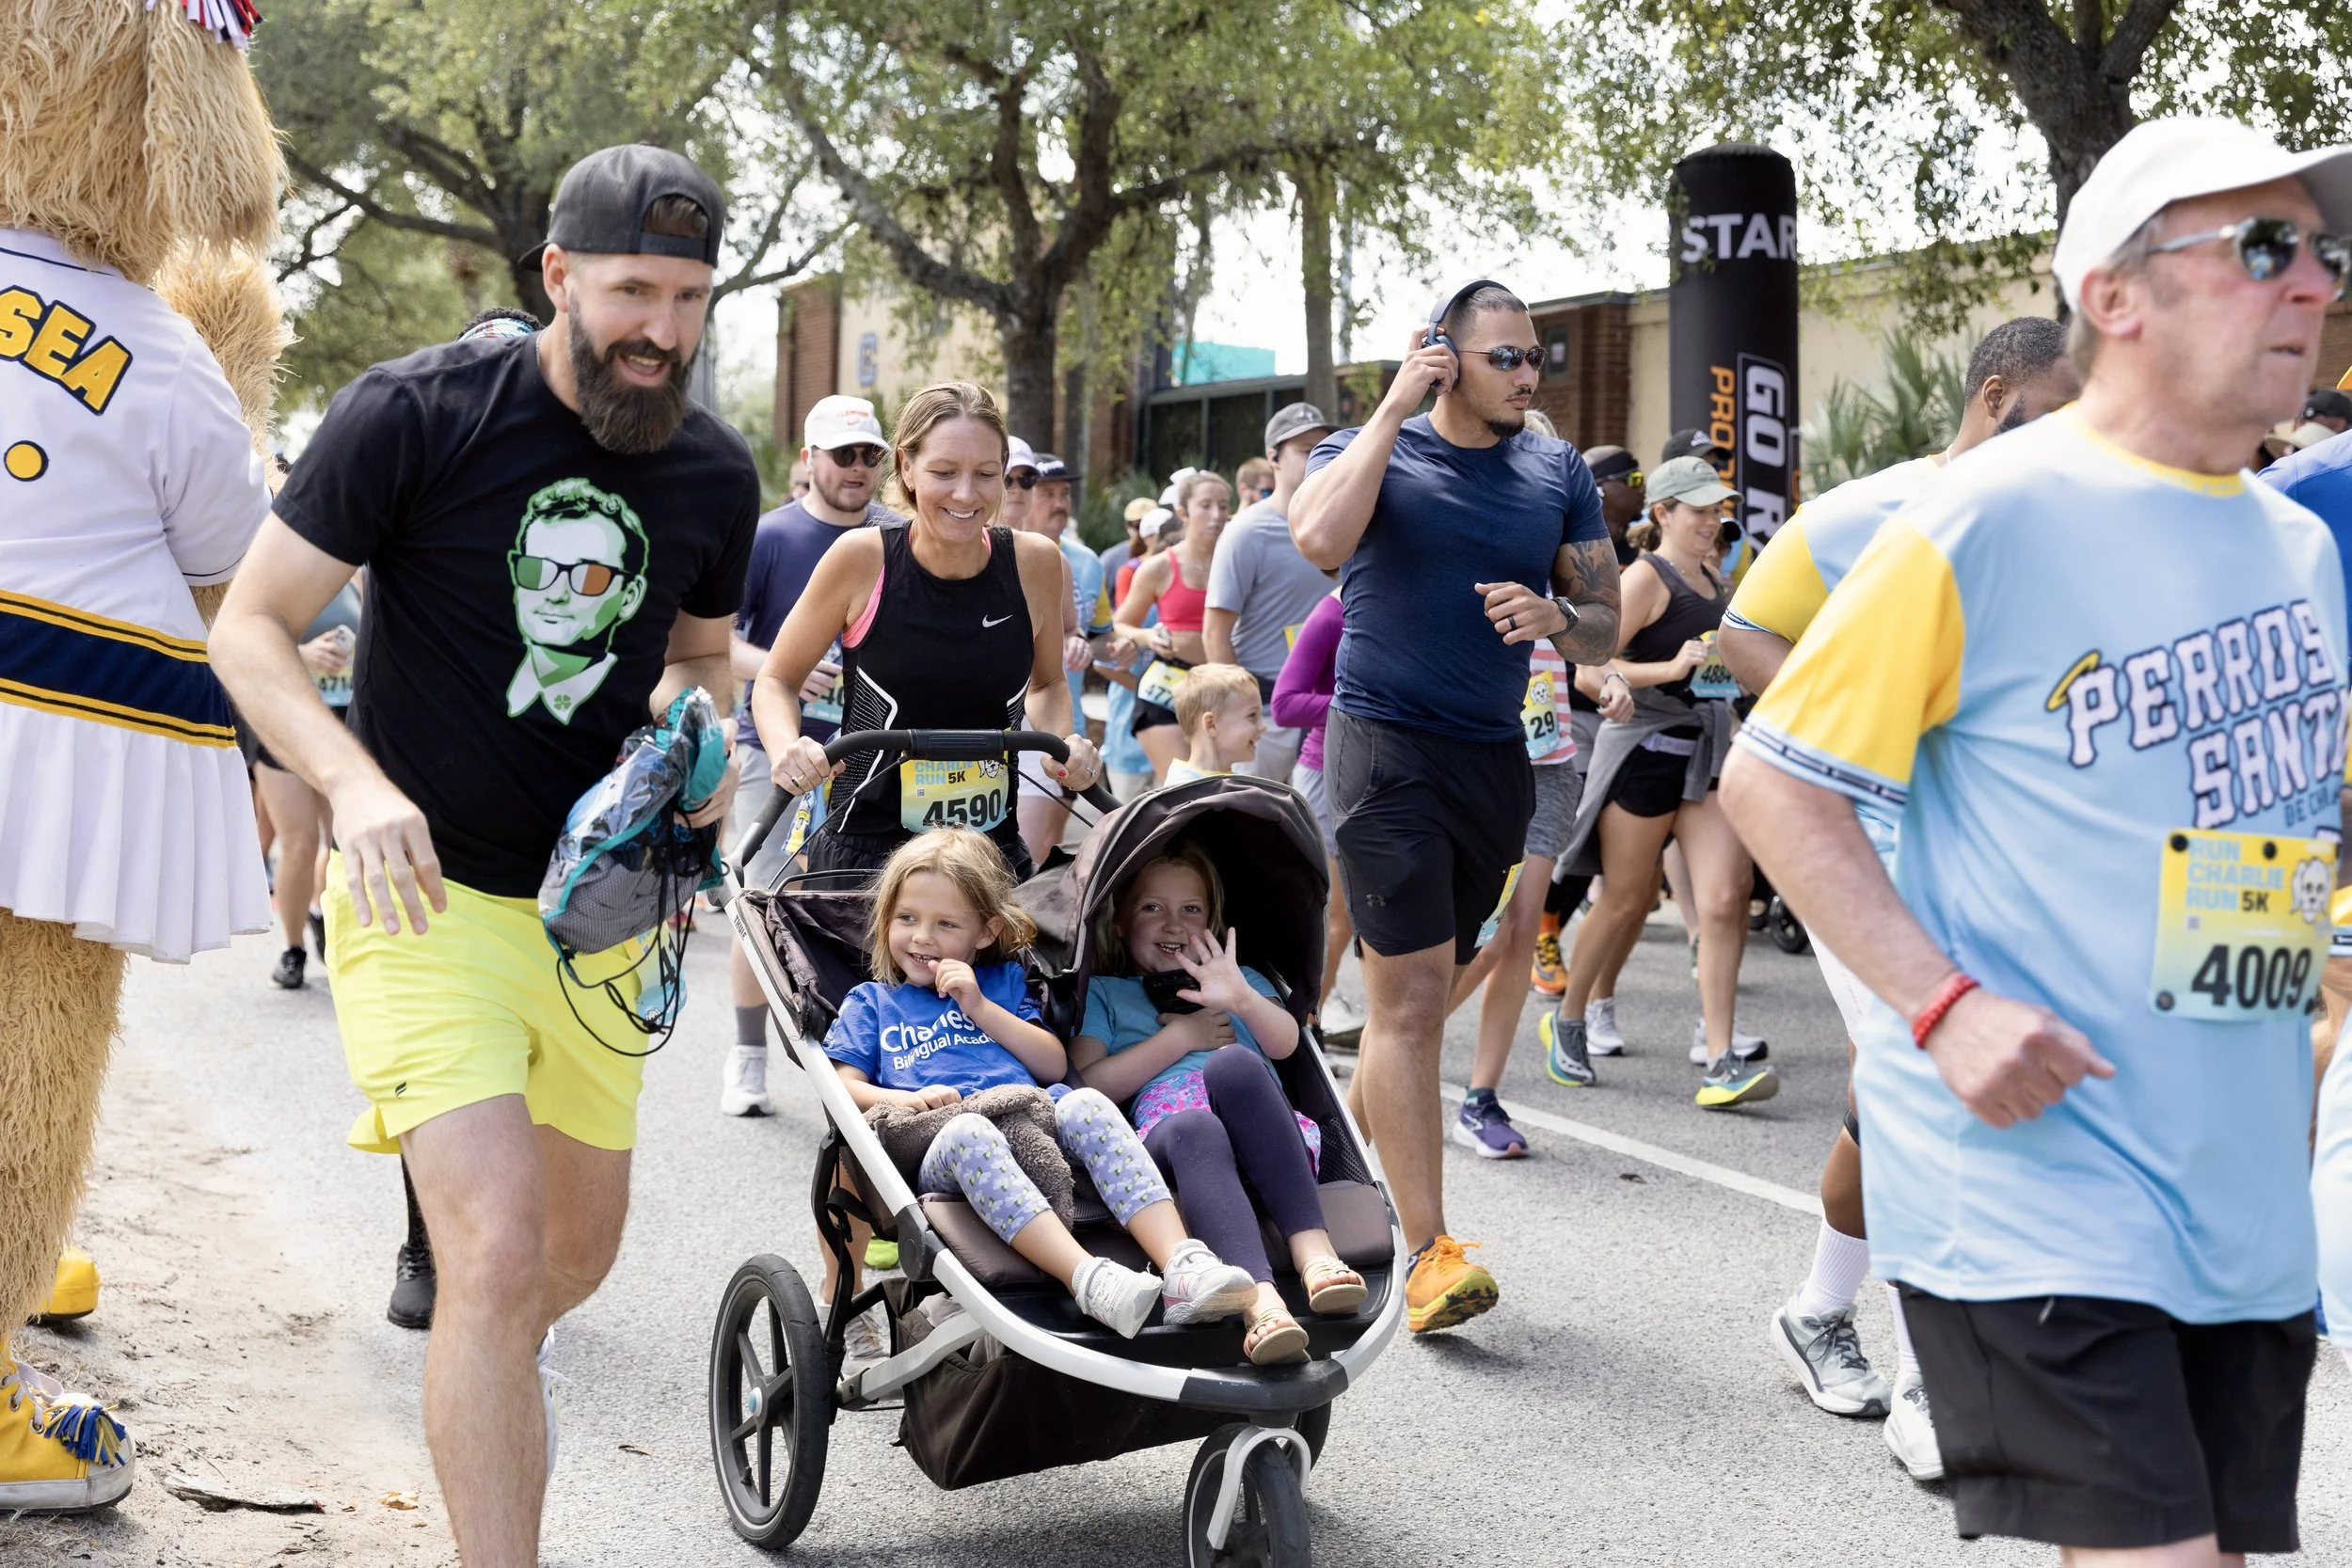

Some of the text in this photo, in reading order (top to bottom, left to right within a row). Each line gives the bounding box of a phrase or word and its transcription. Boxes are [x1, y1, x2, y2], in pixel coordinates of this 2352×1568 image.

[1745, 365, 1786, 467] GO
[2067, 599, 2335, 769] PERROS
[914, 770, 966, 785] RUN 5K
[923, 788, 1001, 828] 4590
[2188, 838, 2241, 862] RUN
[2187, 862, 2285, 890] CHARLIE
[2185, 886, 2269, 912] RUN 5K
[2190, 944, 2312, 1010] 4009
